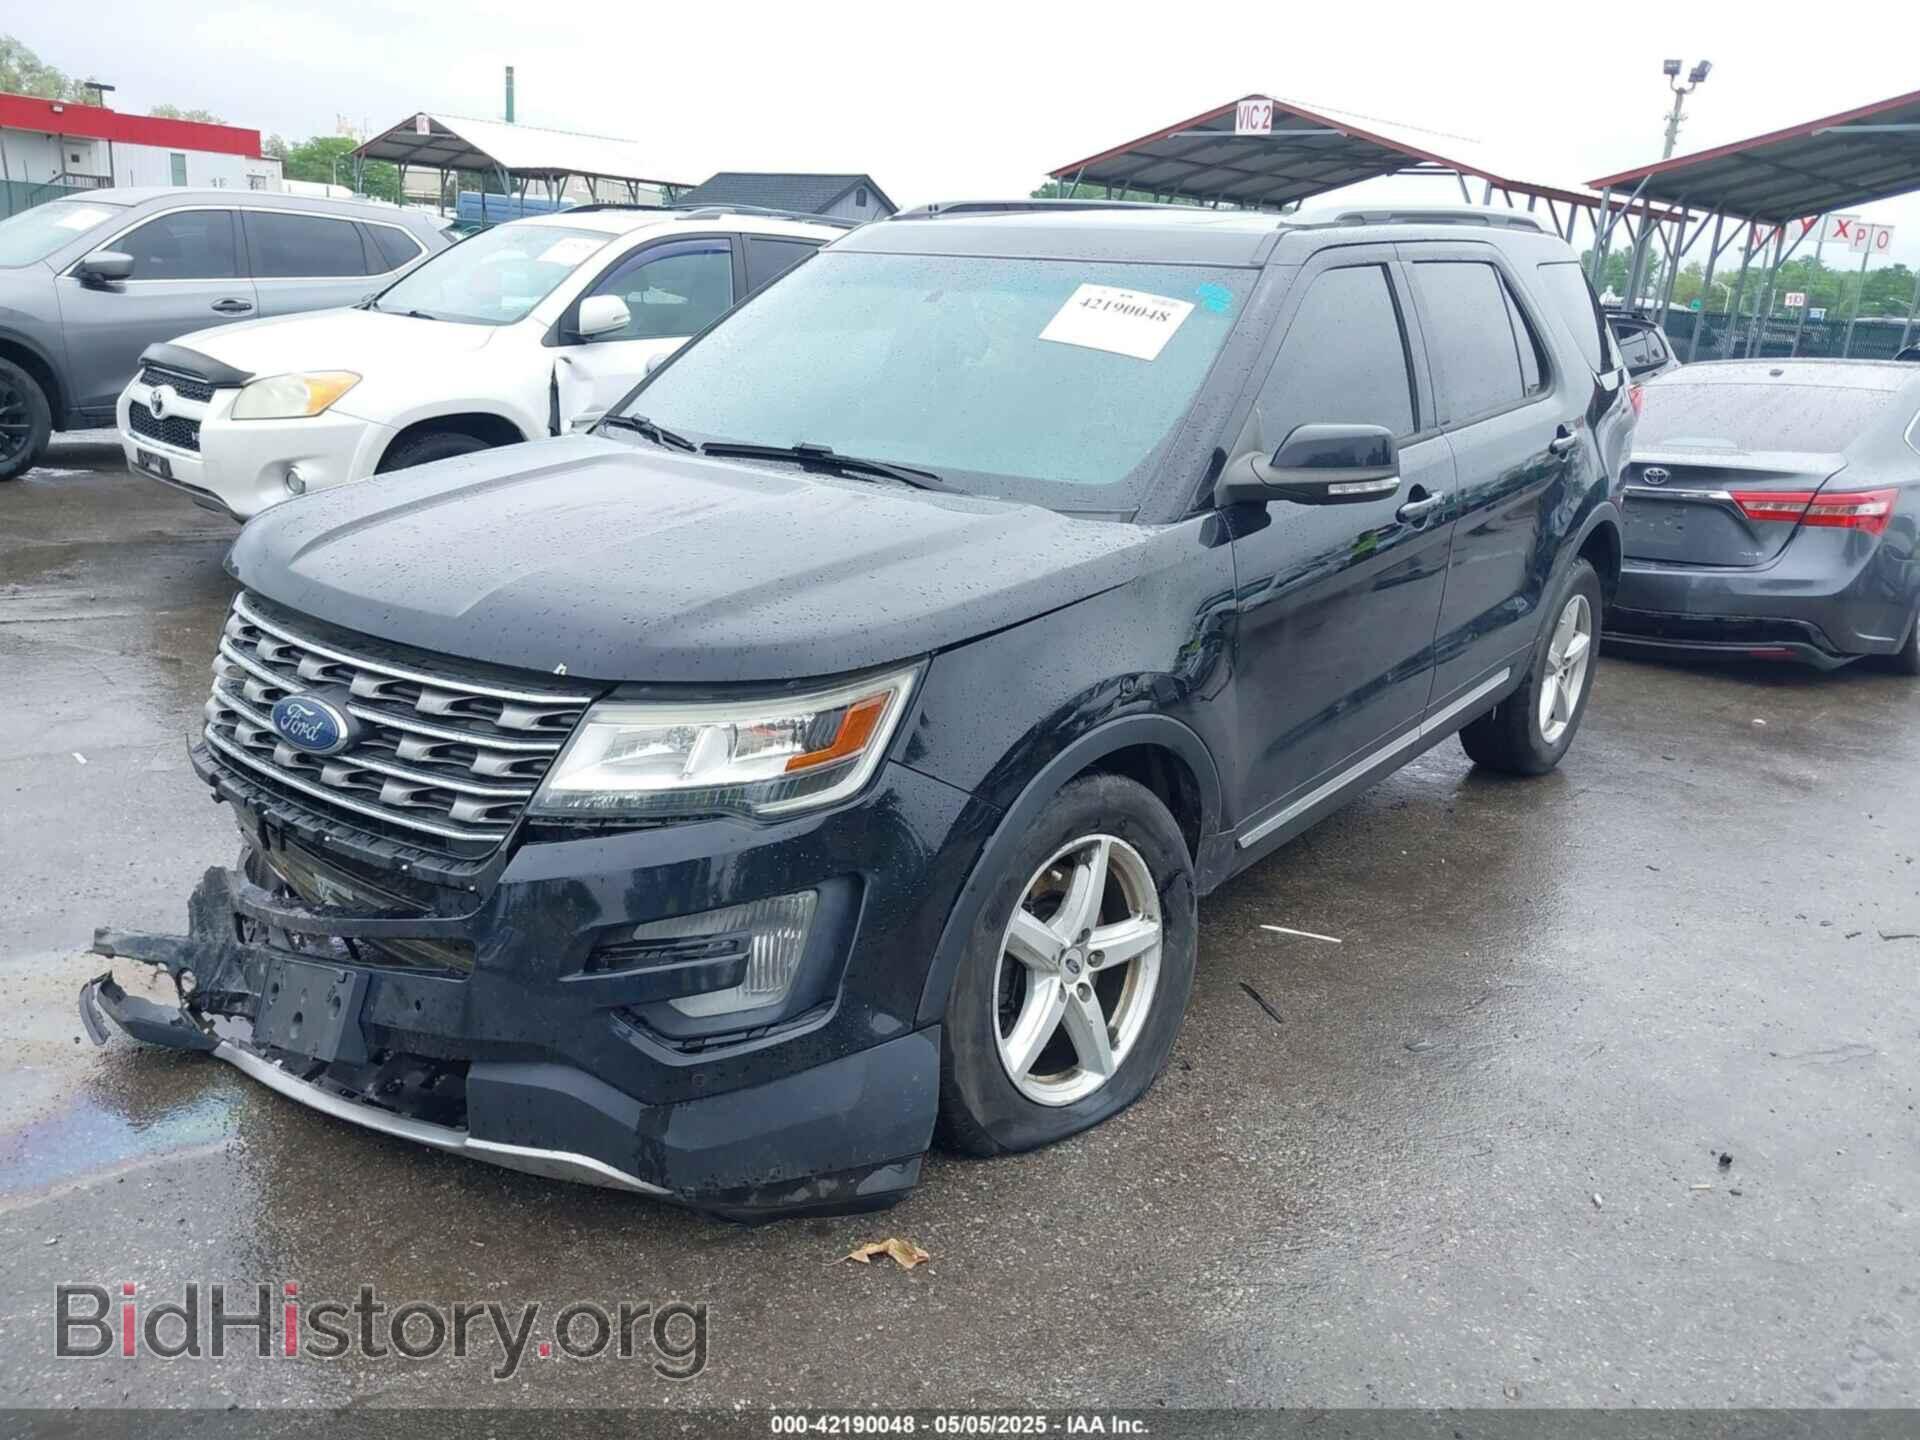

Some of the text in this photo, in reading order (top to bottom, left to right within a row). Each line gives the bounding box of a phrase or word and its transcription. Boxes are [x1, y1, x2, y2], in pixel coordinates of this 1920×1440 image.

[1238, 105, 1272, 129] VIC 2
[1832, 219, 1852, 238] X
[1854, 228, 1866, 246] P
[1080, 298, 1171, 322] 42190048
[280, 703, 323, 742] Ford
